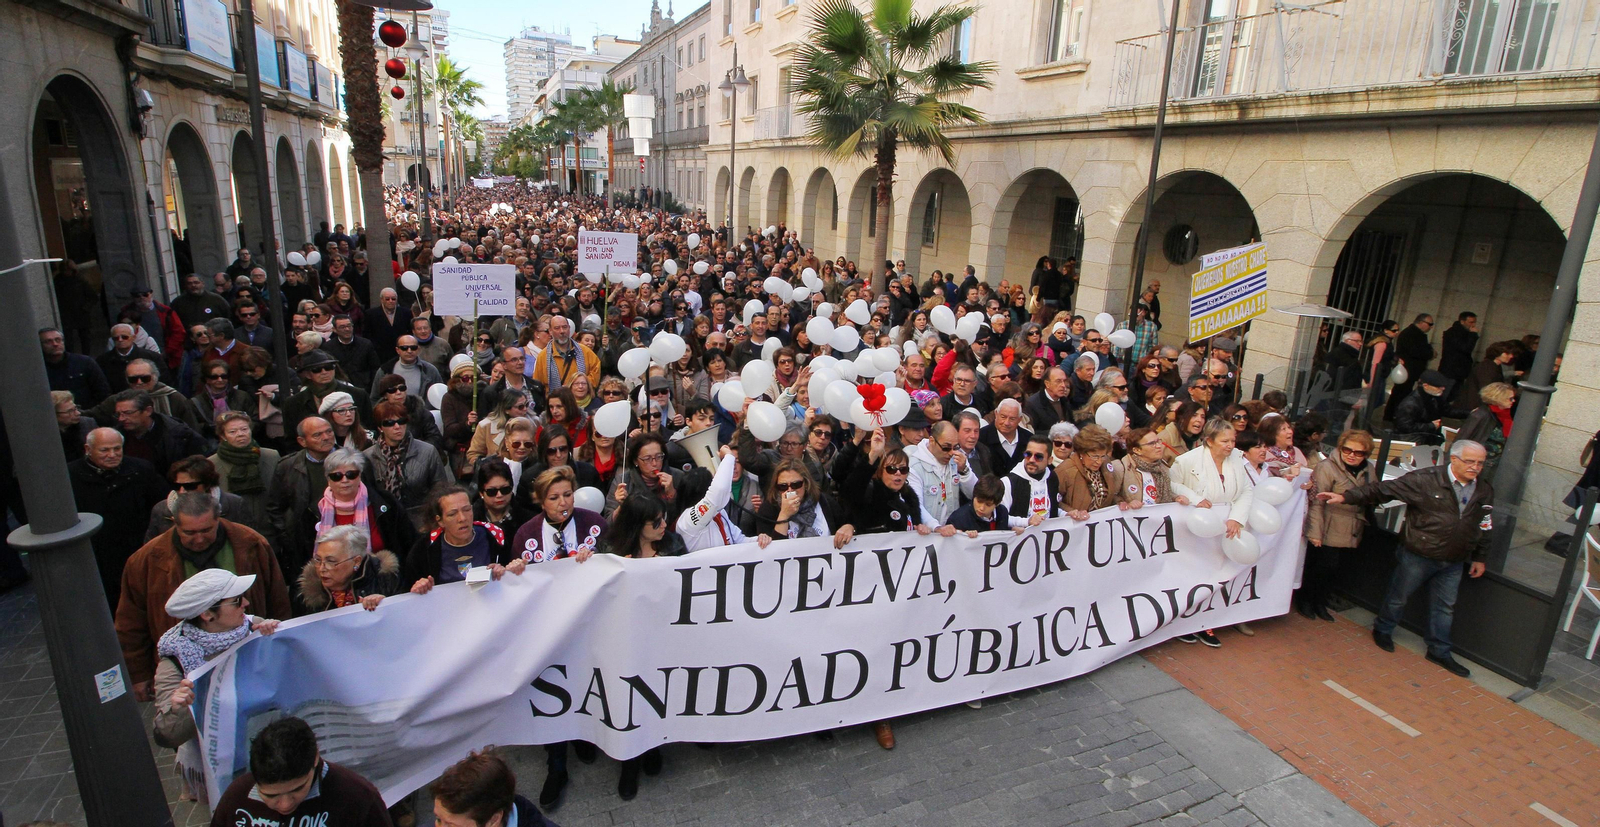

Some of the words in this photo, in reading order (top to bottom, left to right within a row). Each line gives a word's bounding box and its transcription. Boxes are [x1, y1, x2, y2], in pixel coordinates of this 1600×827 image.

[585, 252, 613, 260] SANIDAD
[439, 266, 473, 274] SANIDAD
[1194, 266, 1224, 293] QUEREMOS
[1225, 257, 1248, 280] NUESTRO
[1249, 248, 1267, 270] CHARE
[461, 273, 488, 281] PÚBLICA
[465, 284, 502, 292] UNIVERSAL
[478, 298, 509, 306] CALIDAD
[670, 544, 957, 625] HUELVA,
[978, 528, 1070, 594] POR
[1085, 514, 1179, 568] UNA
[529, 648, 869, 732] SANIDAD
[885, 613, 1116, 693] PÚBLICA
[1121, 565, 1261, 642] DIGNA
